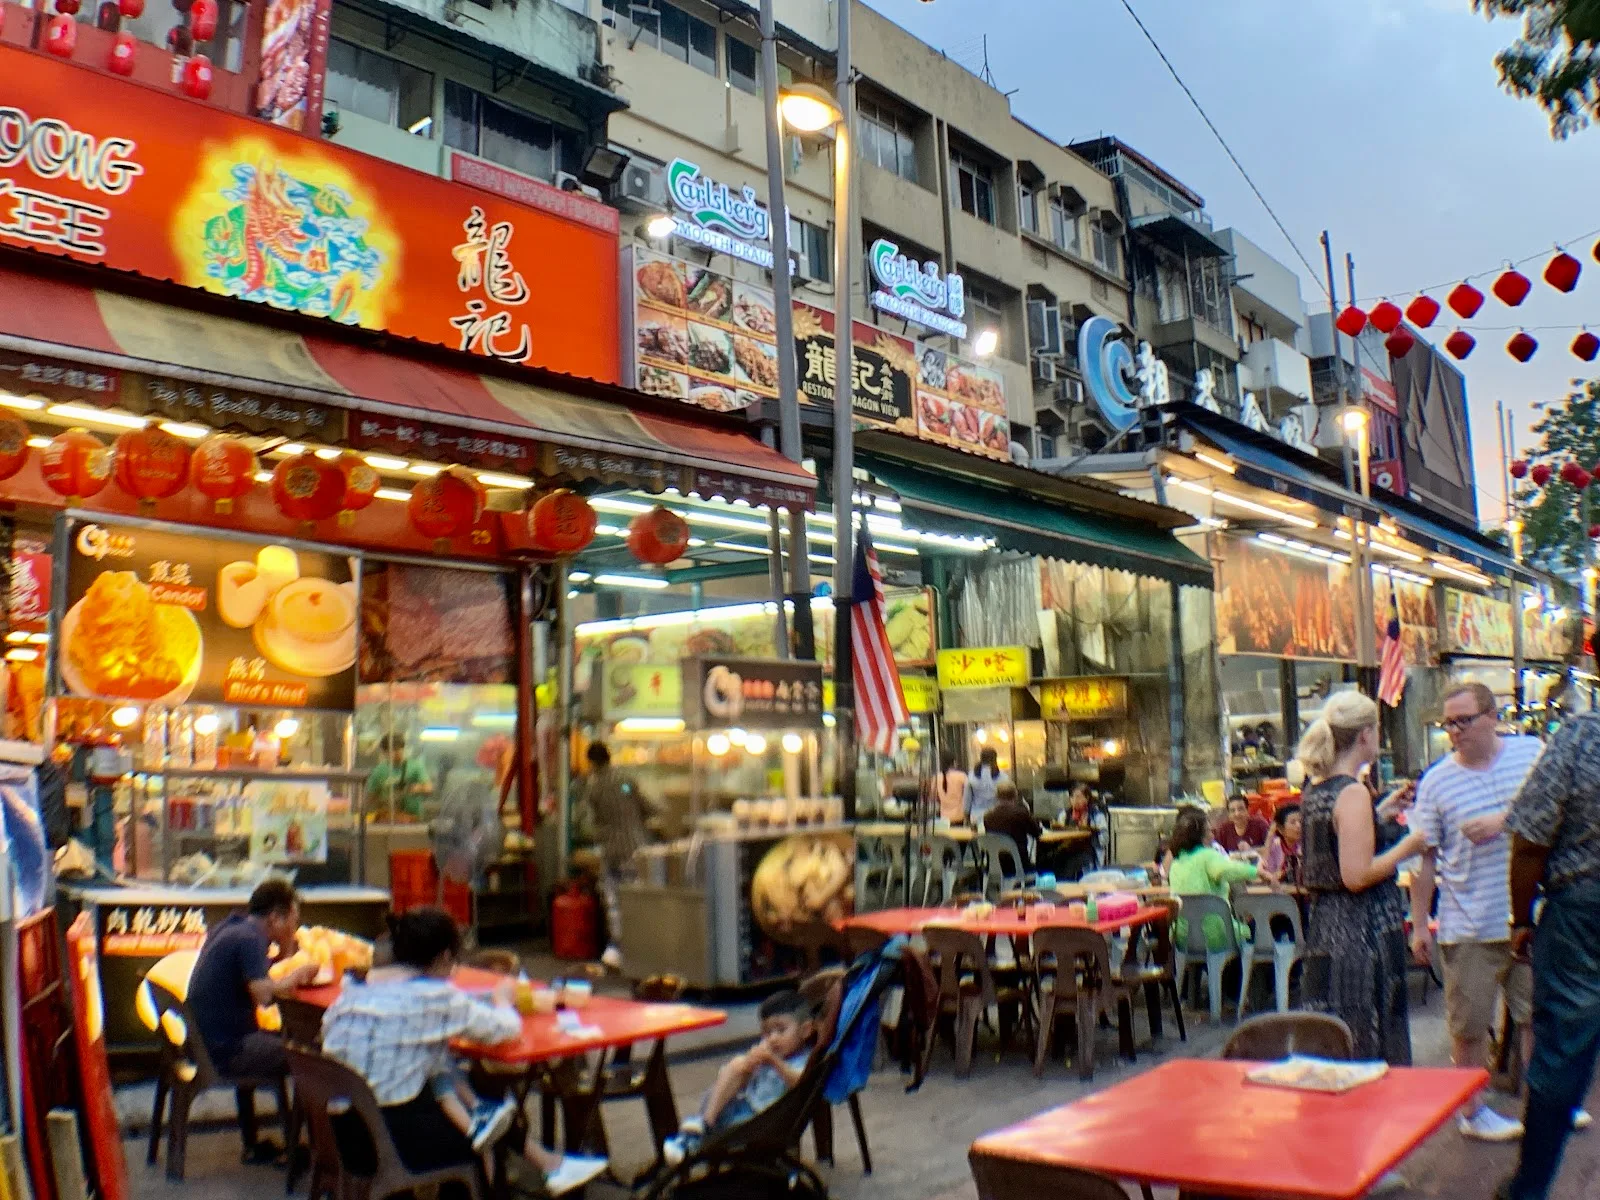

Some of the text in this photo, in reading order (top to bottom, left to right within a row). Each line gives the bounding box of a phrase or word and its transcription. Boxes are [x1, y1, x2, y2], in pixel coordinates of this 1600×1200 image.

[668, 157, 769, 240] Carlsberg
[673, 217, 731, 254] MOOTH
[449, 205, 532, 363] 龍記
[870, 239, 947, 308] Carlsberg
[881, 403, 900, 418] VIEW
[272, 684, 305, 702] Nest
